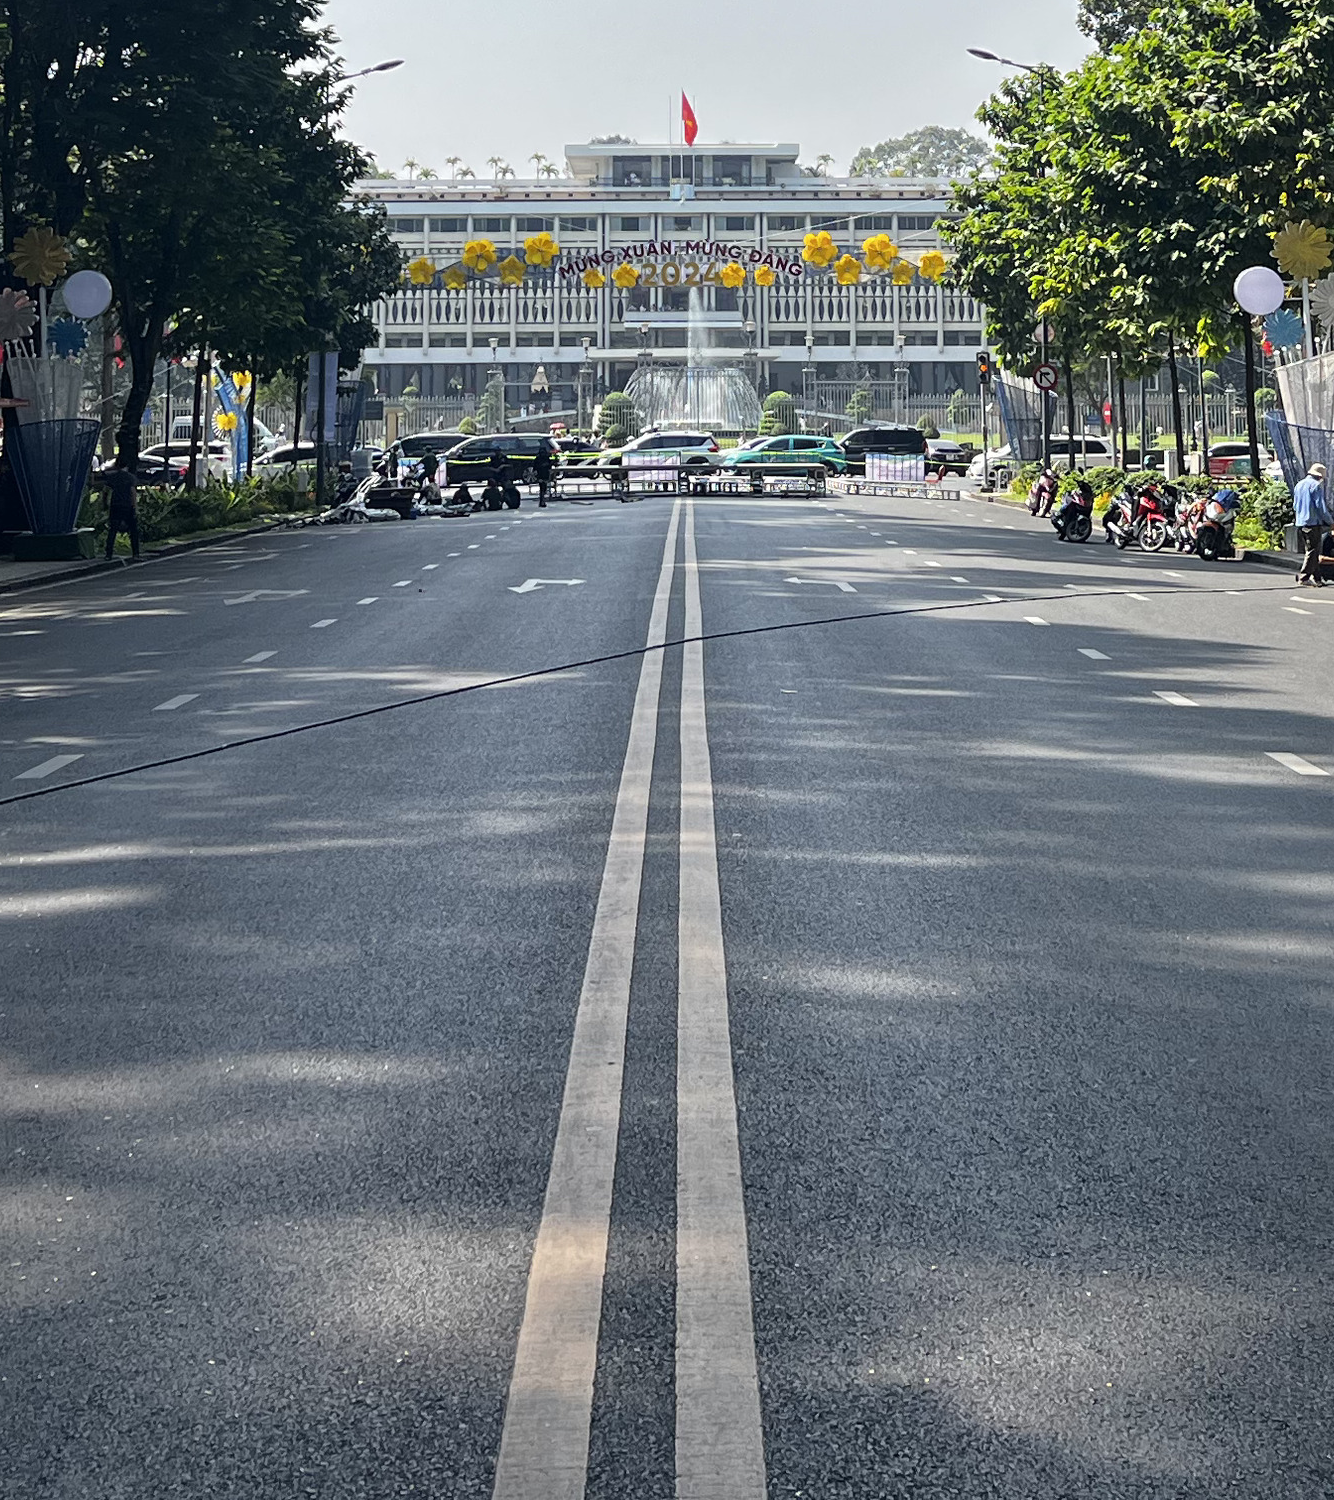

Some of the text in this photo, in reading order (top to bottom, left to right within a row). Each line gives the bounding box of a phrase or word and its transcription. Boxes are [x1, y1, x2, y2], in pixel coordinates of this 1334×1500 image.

[620, 239, 677, 261] XUÂN,
[686, 237, 743, 259] MỪNG
[749, 249, 803, 277] ĐẢNG
[642, 261, 721, 287] 2024
